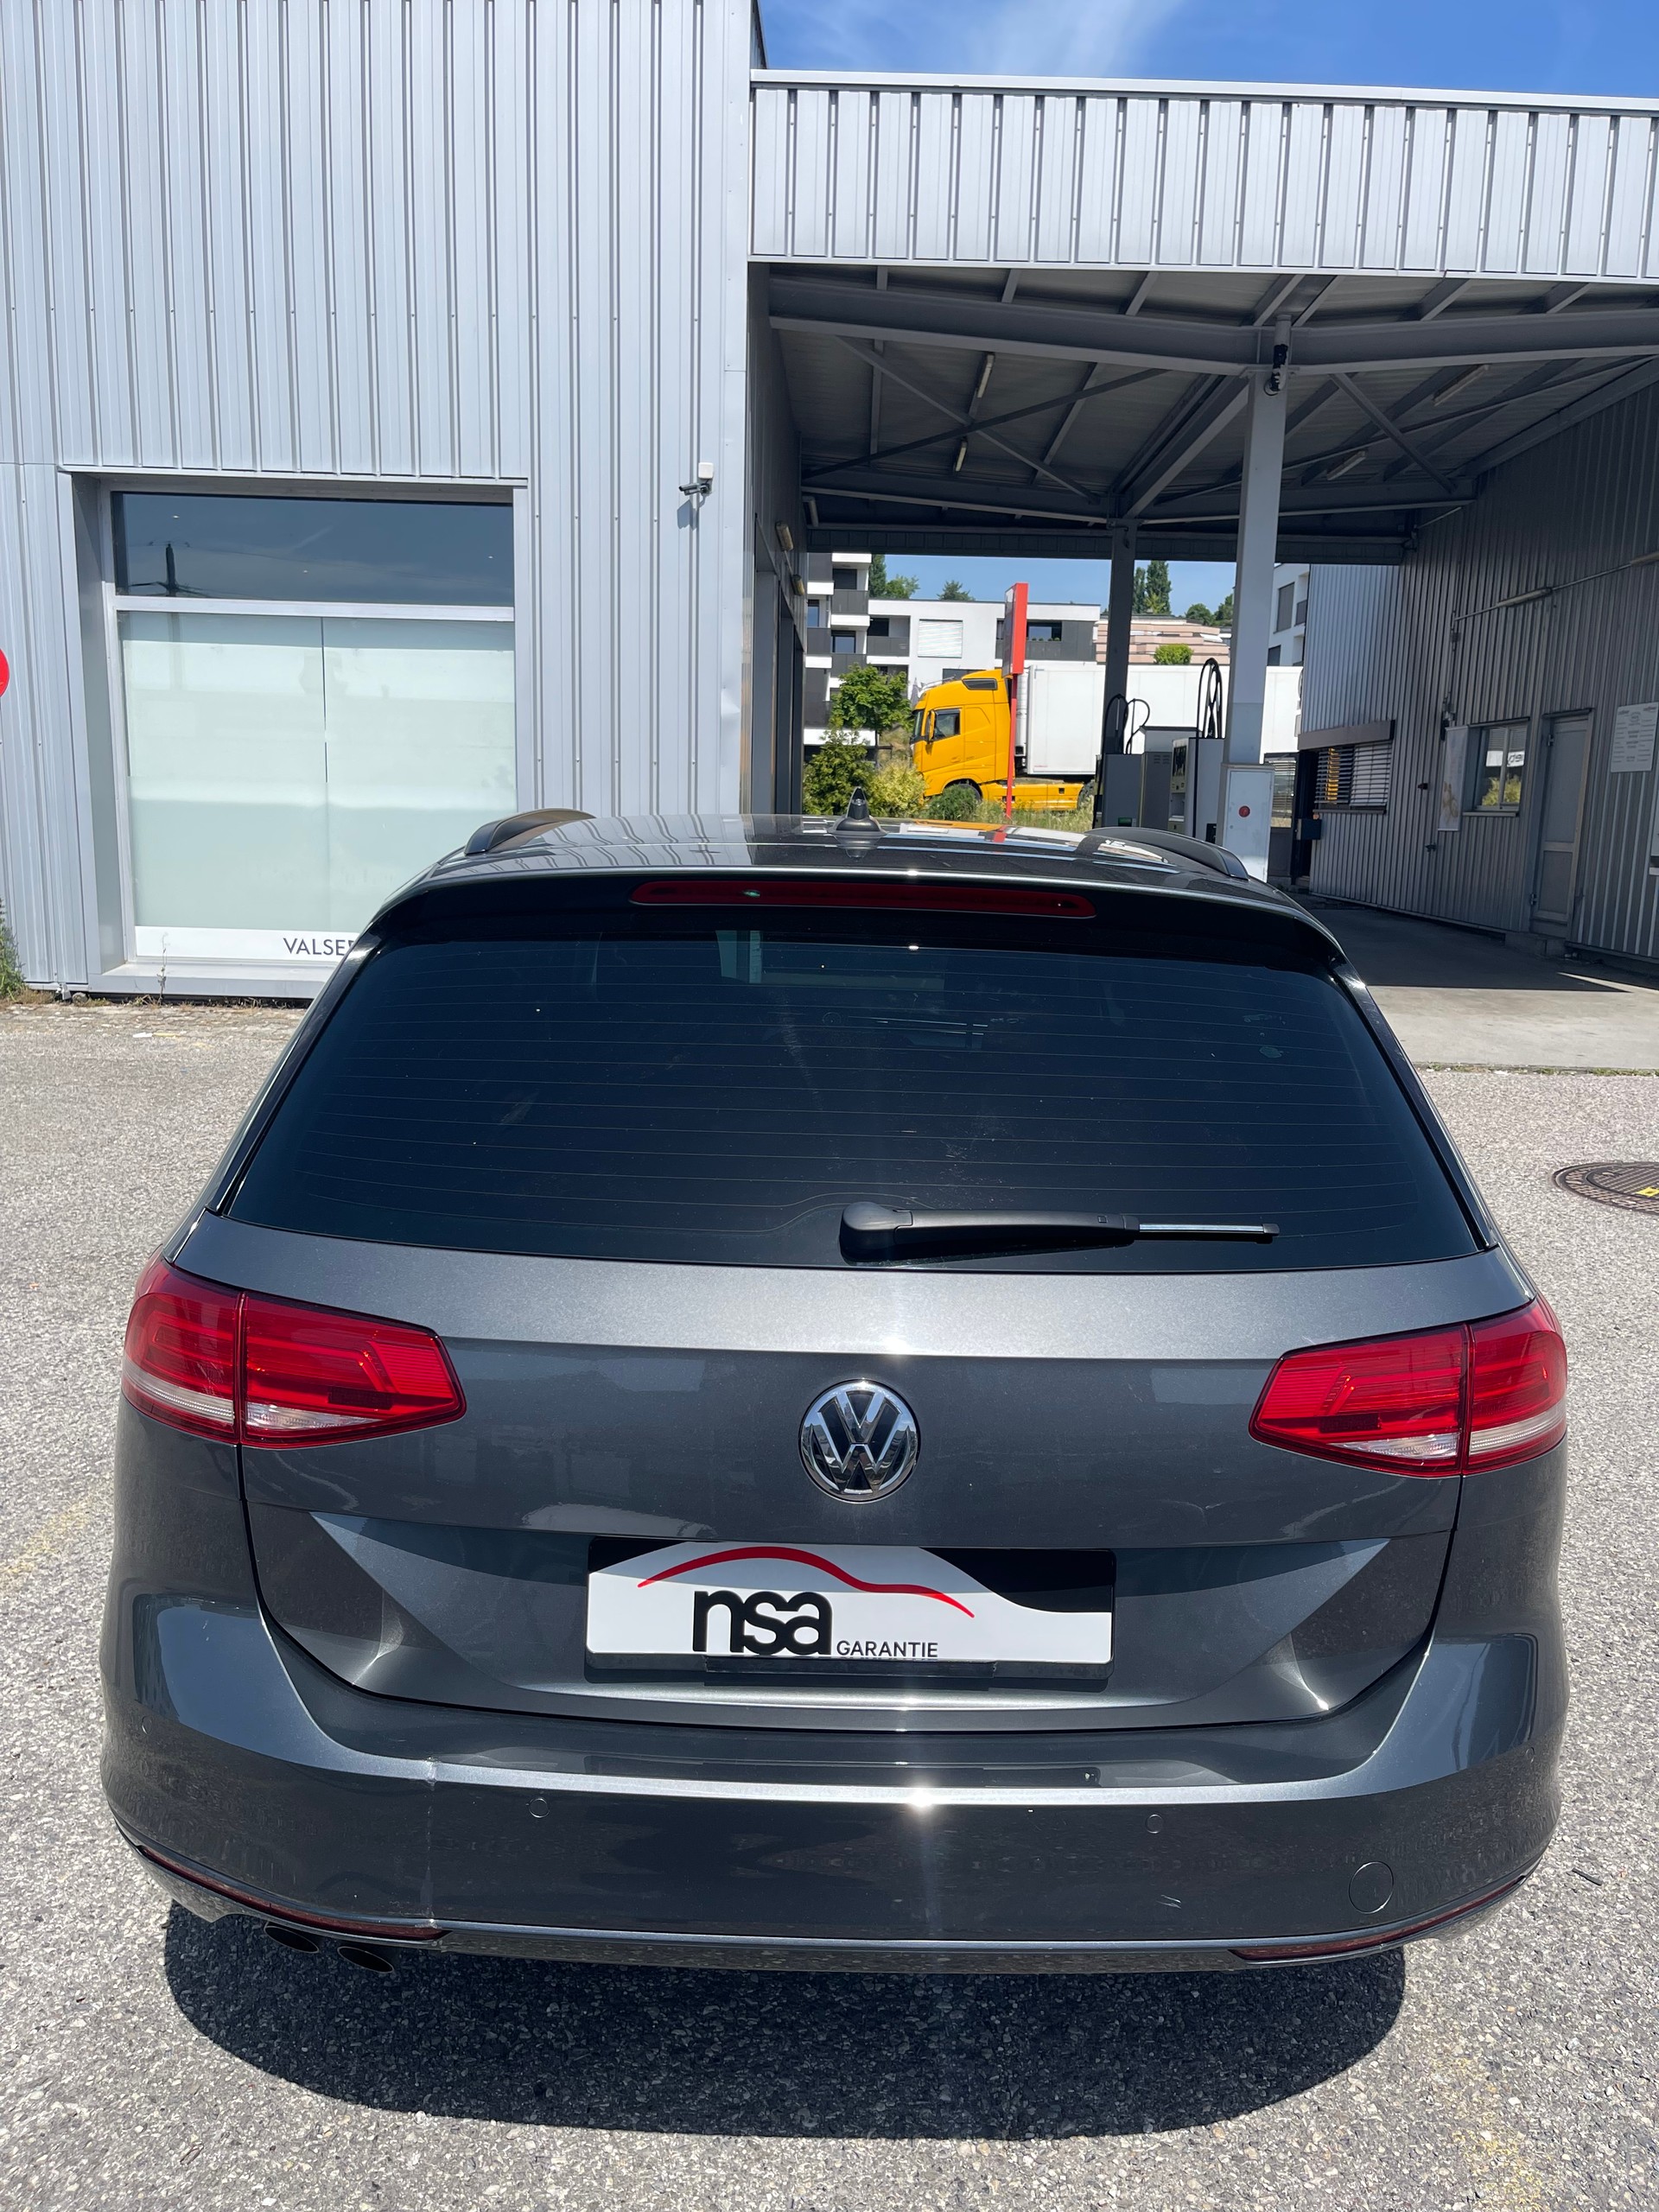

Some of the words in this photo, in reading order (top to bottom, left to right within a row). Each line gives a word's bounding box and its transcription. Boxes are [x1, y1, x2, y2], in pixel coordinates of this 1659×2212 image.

[804, 1384, 916, 1497] VW
[692, 1590, 833, 1656] nsa
[836, 1639, 938, 1658] GARANTIE
